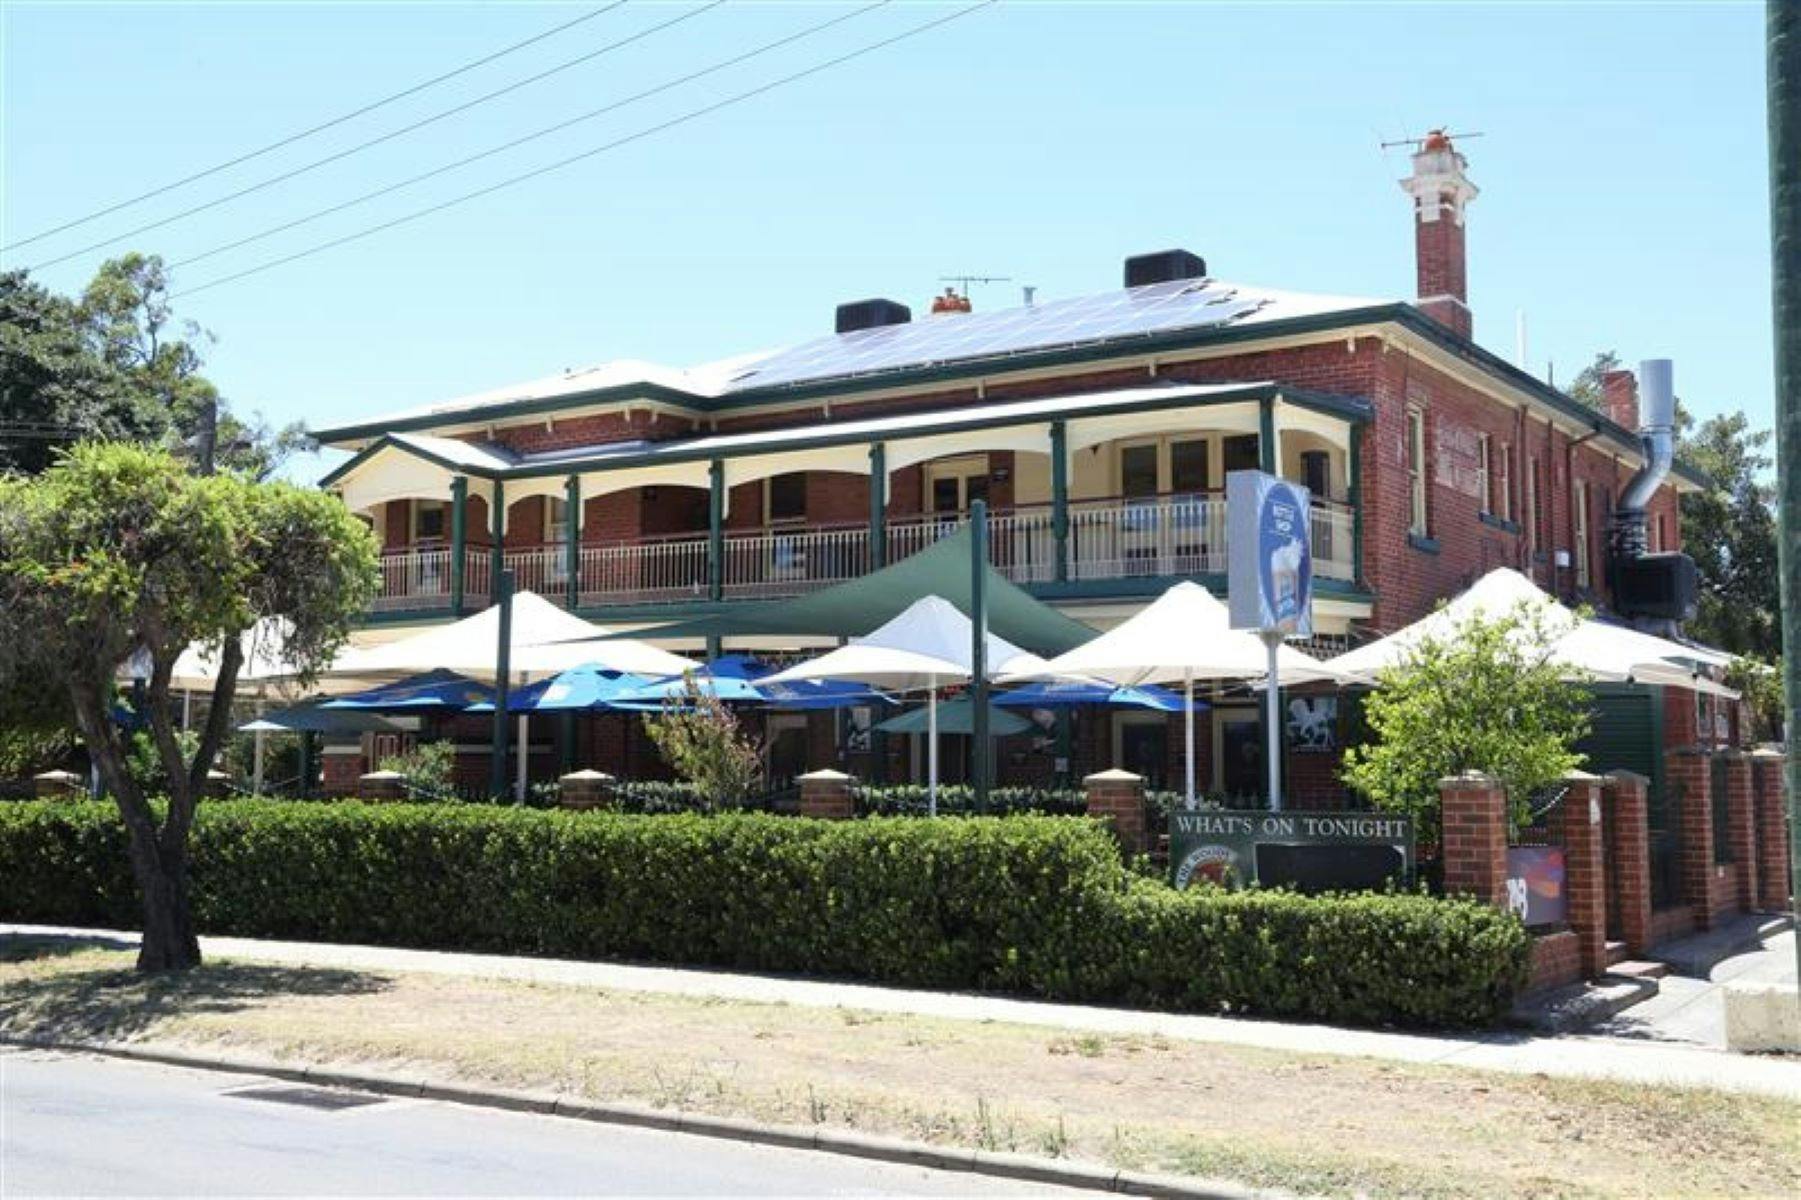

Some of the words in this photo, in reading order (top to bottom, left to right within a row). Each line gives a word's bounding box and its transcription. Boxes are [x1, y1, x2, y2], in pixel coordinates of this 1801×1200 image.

[1176, 815, 1253, 835] WHAT'S
[1262, 817, 1295, 836] ON
[1302, 818, 1407, 838] TONIGHT
